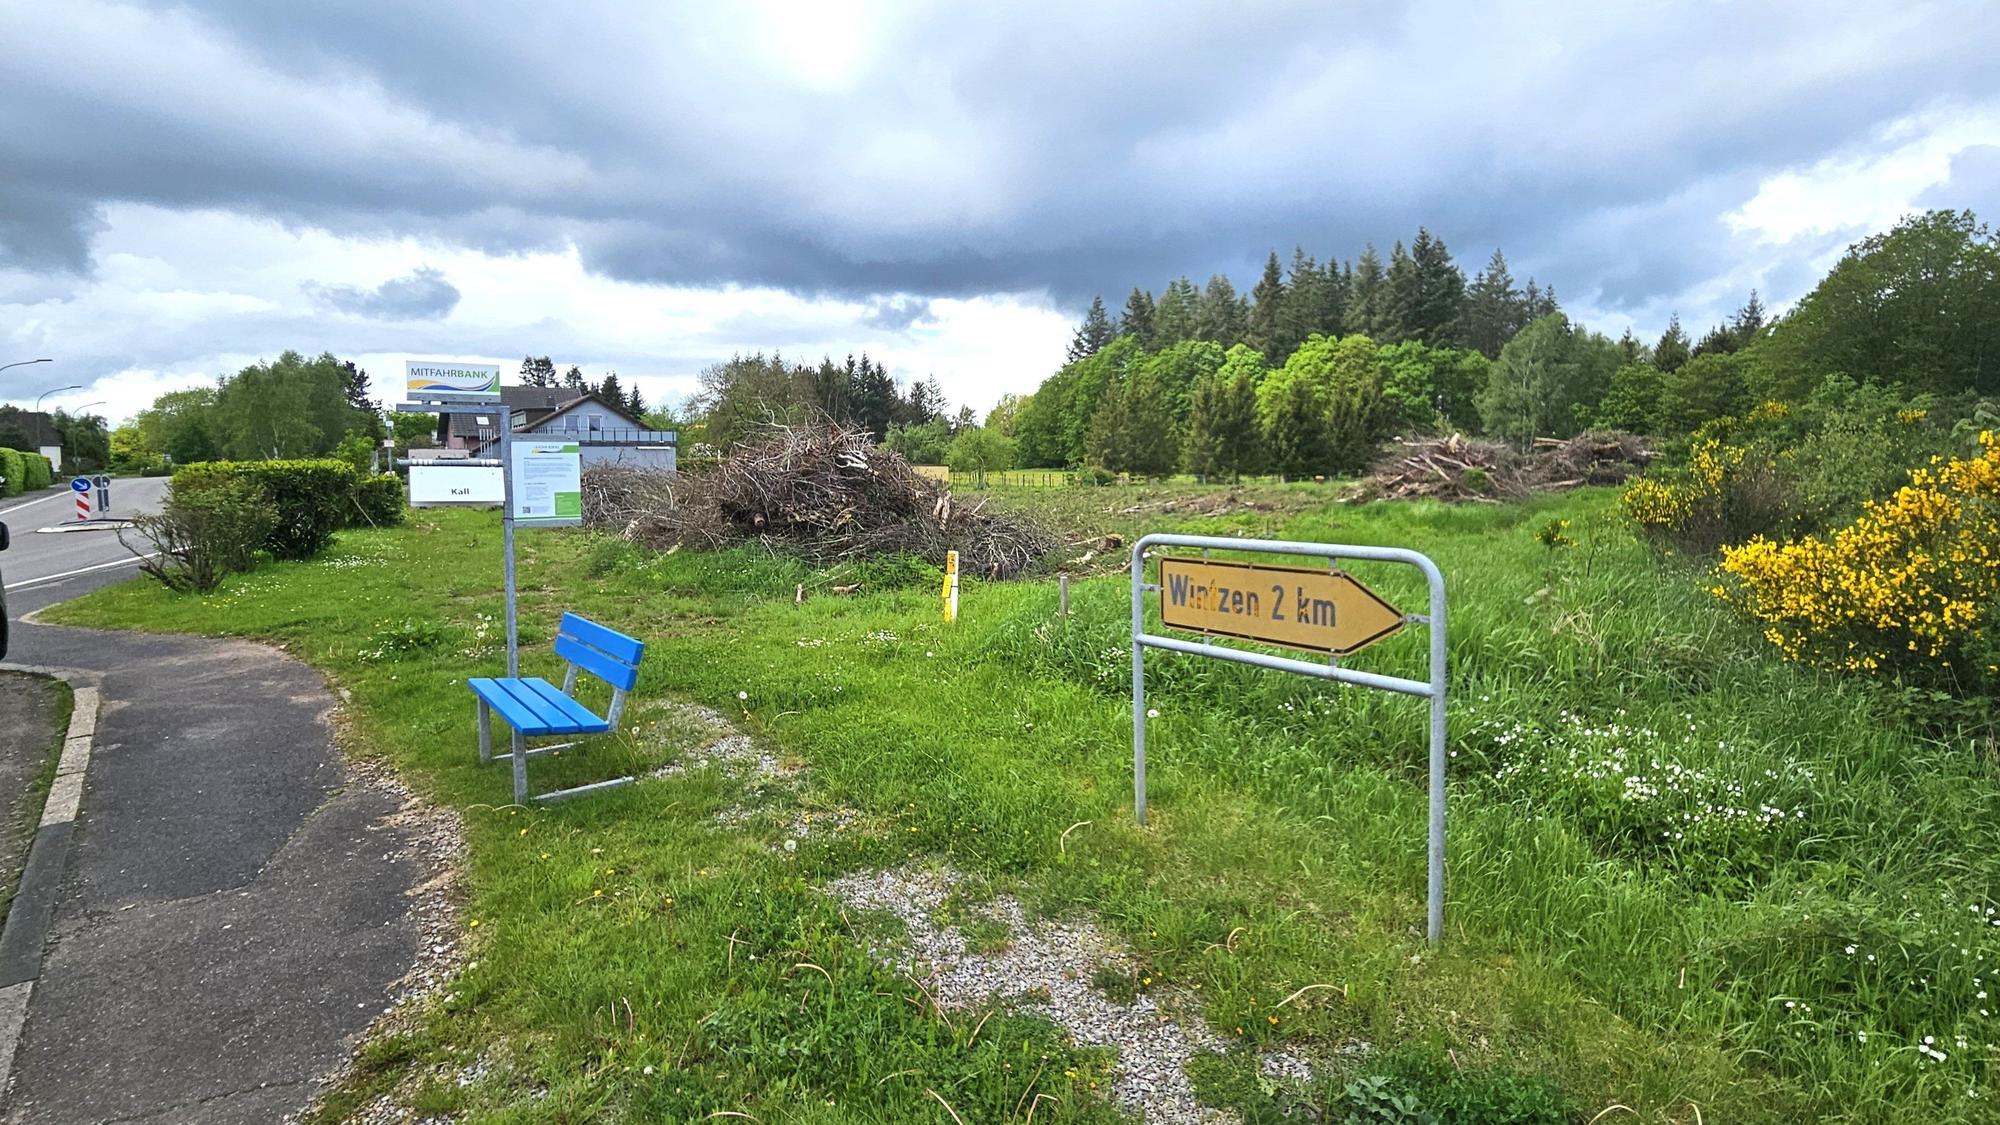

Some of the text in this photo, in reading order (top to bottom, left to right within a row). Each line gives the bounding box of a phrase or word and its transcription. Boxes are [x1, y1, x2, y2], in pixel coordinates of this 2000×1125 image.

[410, 367, 488, 379] MITFAHRBANK
[450, 487, 470, 496] Kall
[1271, 585, 1285, 620] 2
[1297, 587, 1336, 627] km
